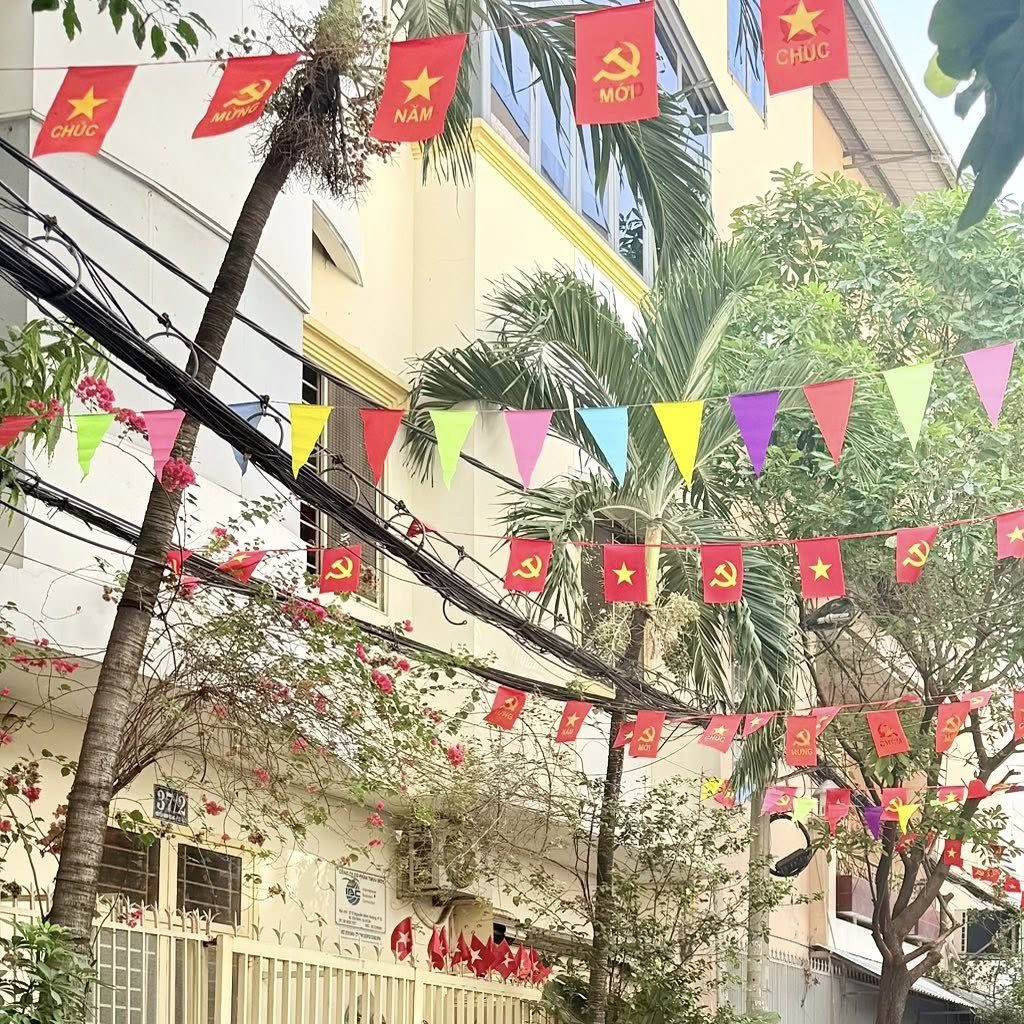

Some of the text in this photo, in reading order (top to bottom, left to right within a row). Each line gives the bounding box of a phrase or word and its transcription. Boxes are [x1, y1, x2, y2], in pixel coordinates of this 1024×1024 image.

[210, 102, 260, 123] MỪNG
[394, 104, 434, 123] NĂM
[50, 121, 99, 138] CHÚC
[157, 789, 186, 815] 37/2
